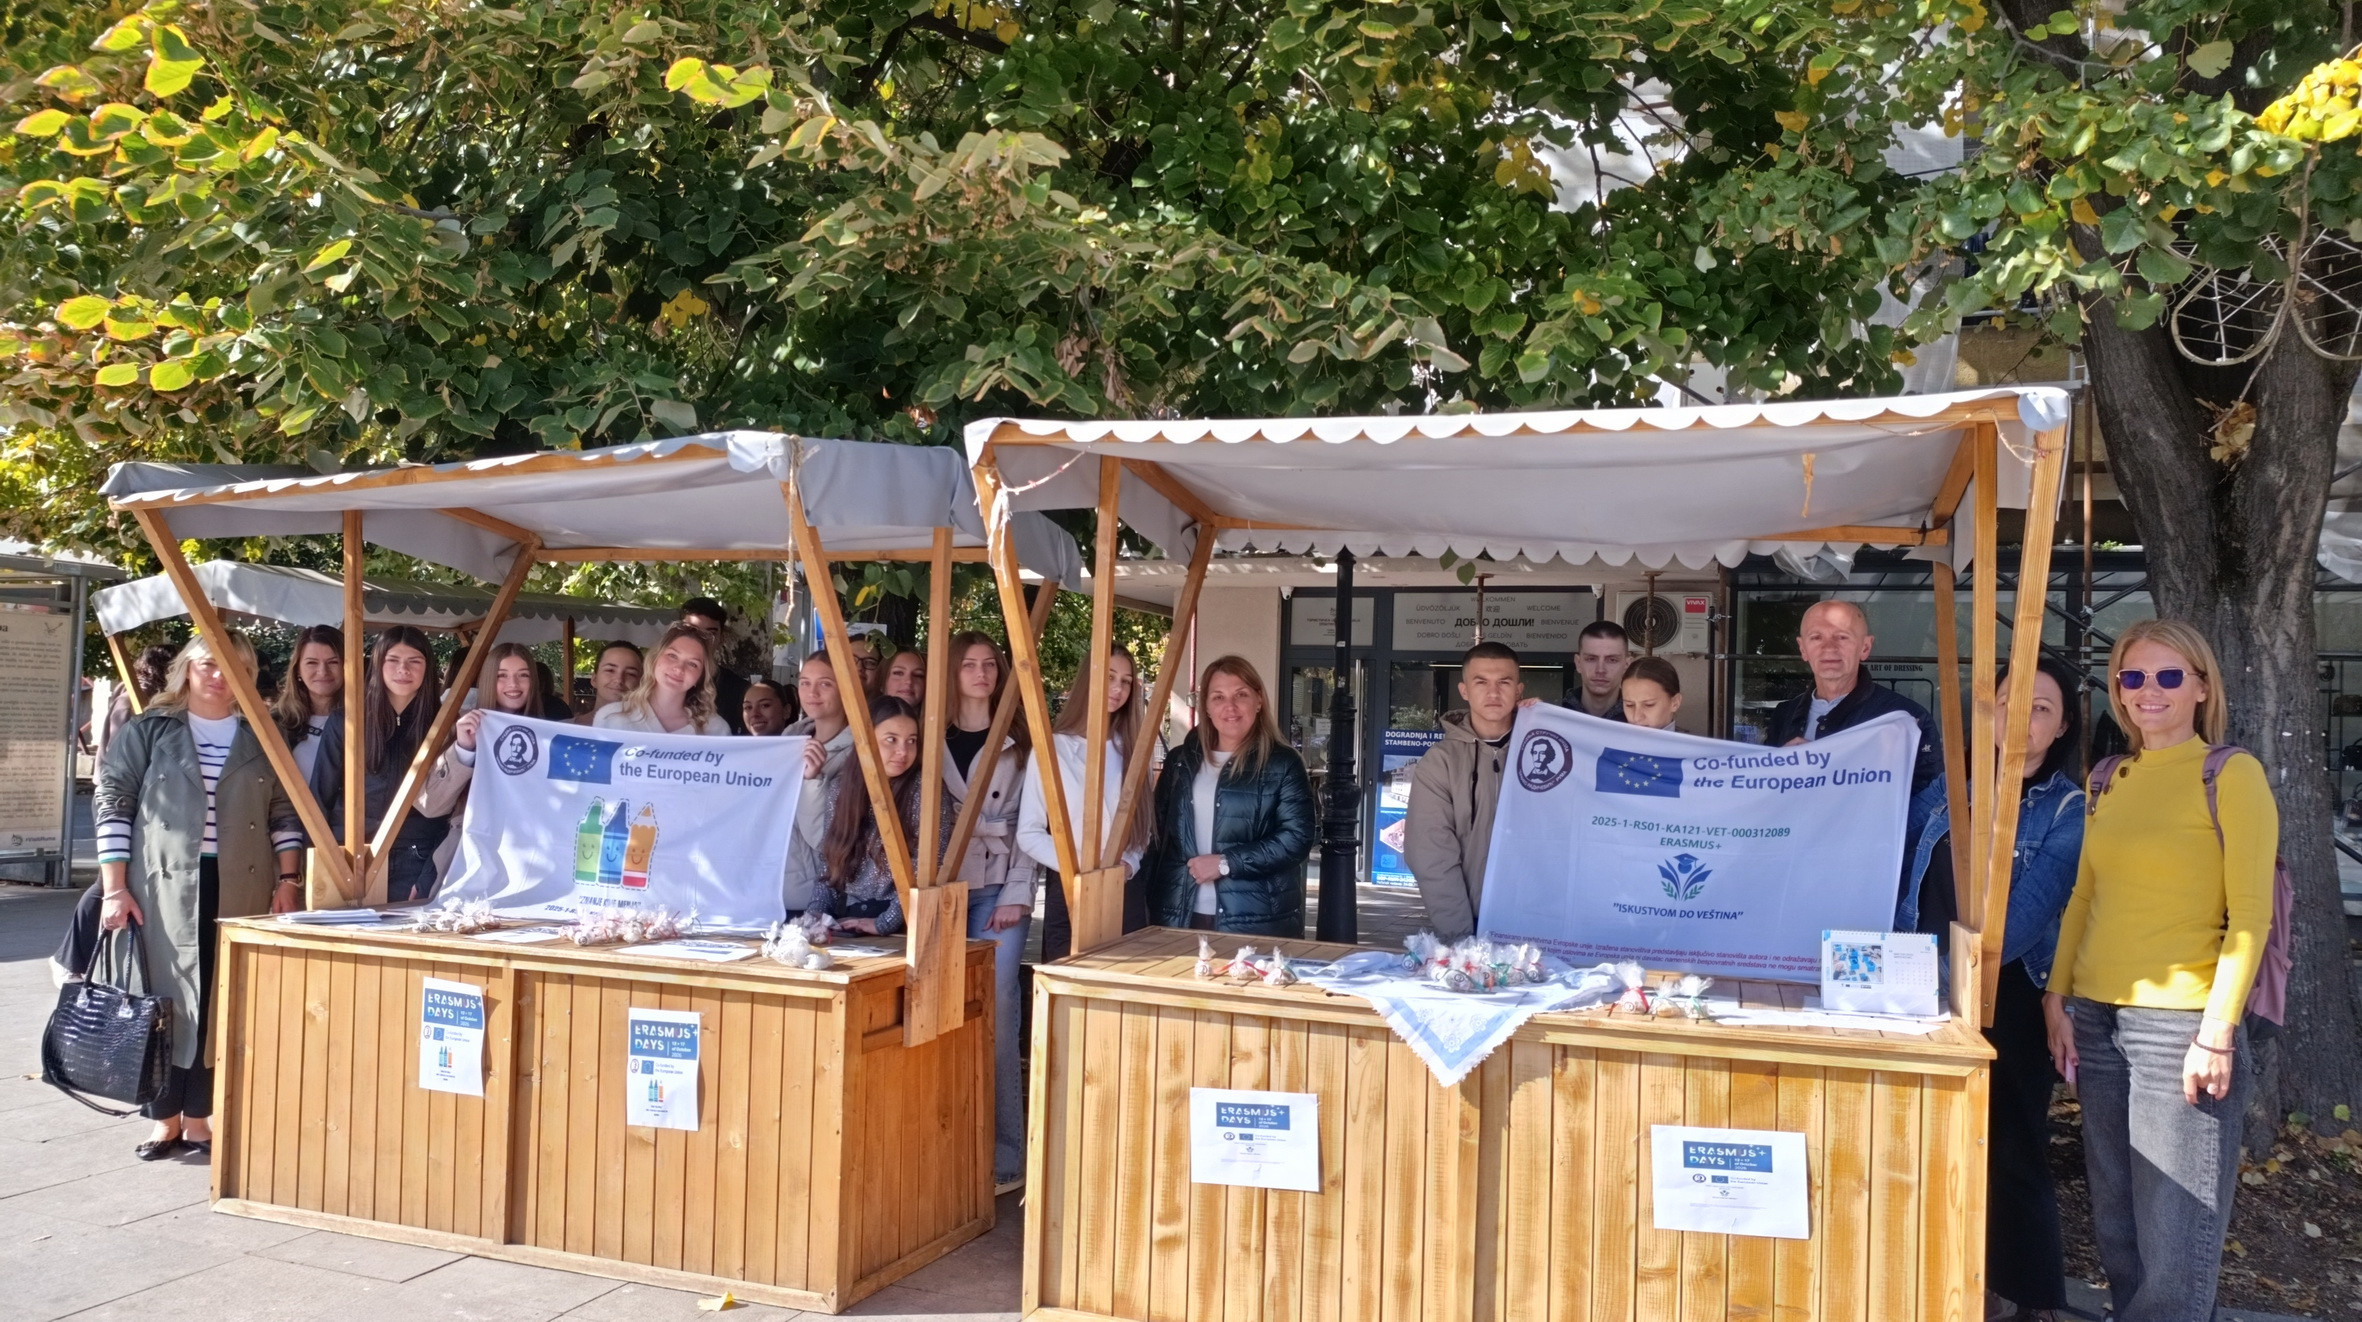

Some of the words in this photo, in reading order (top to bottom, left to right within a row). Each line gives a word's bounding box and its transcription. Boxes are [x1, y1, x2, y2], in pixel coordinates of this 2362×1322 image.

[1455, 618, 1490, 628] ДОБО
[1492, 618, 1535, 628] ДОШЛИ!
[1894, 664, 1923, 672] DRESSING
[1385, 731, 1428, 740] DOGRADNJA
[625, 747, 703, 762] Co-funded
[705, 751, 724, 767] by
[1693, 751, 1799, 771] Co-funded
[1805, 750, 1831, 769] by
[619, 762, 642, 777] the
[647, 764, 720, 784] European
[725, 771, 772, 787] Union
[1693, 776, 1724, 788] the
[1731, 774, 1826, 794] European
[1832, 767, 1891, 786] Union
[1591, 815, 1791, 838] 2025-1-RS01-KA121-VET-000312089
[1660, 837, 1722, 850] ERASMUS+
[1679, 909, 1695, 919] DO
[1553, 938, 1578, 948] Evropske
[1748, 953, 1768, 961] autora
[1594, 951, 1620, 960] Evropska
[427, 1006, 454, 1019] DAYS
[634, 1038, 665, 1051] DAYS
[1221, 1115, 1251, 1125] DAYS
[1689, 1156, 1725, 1166] DAYS
